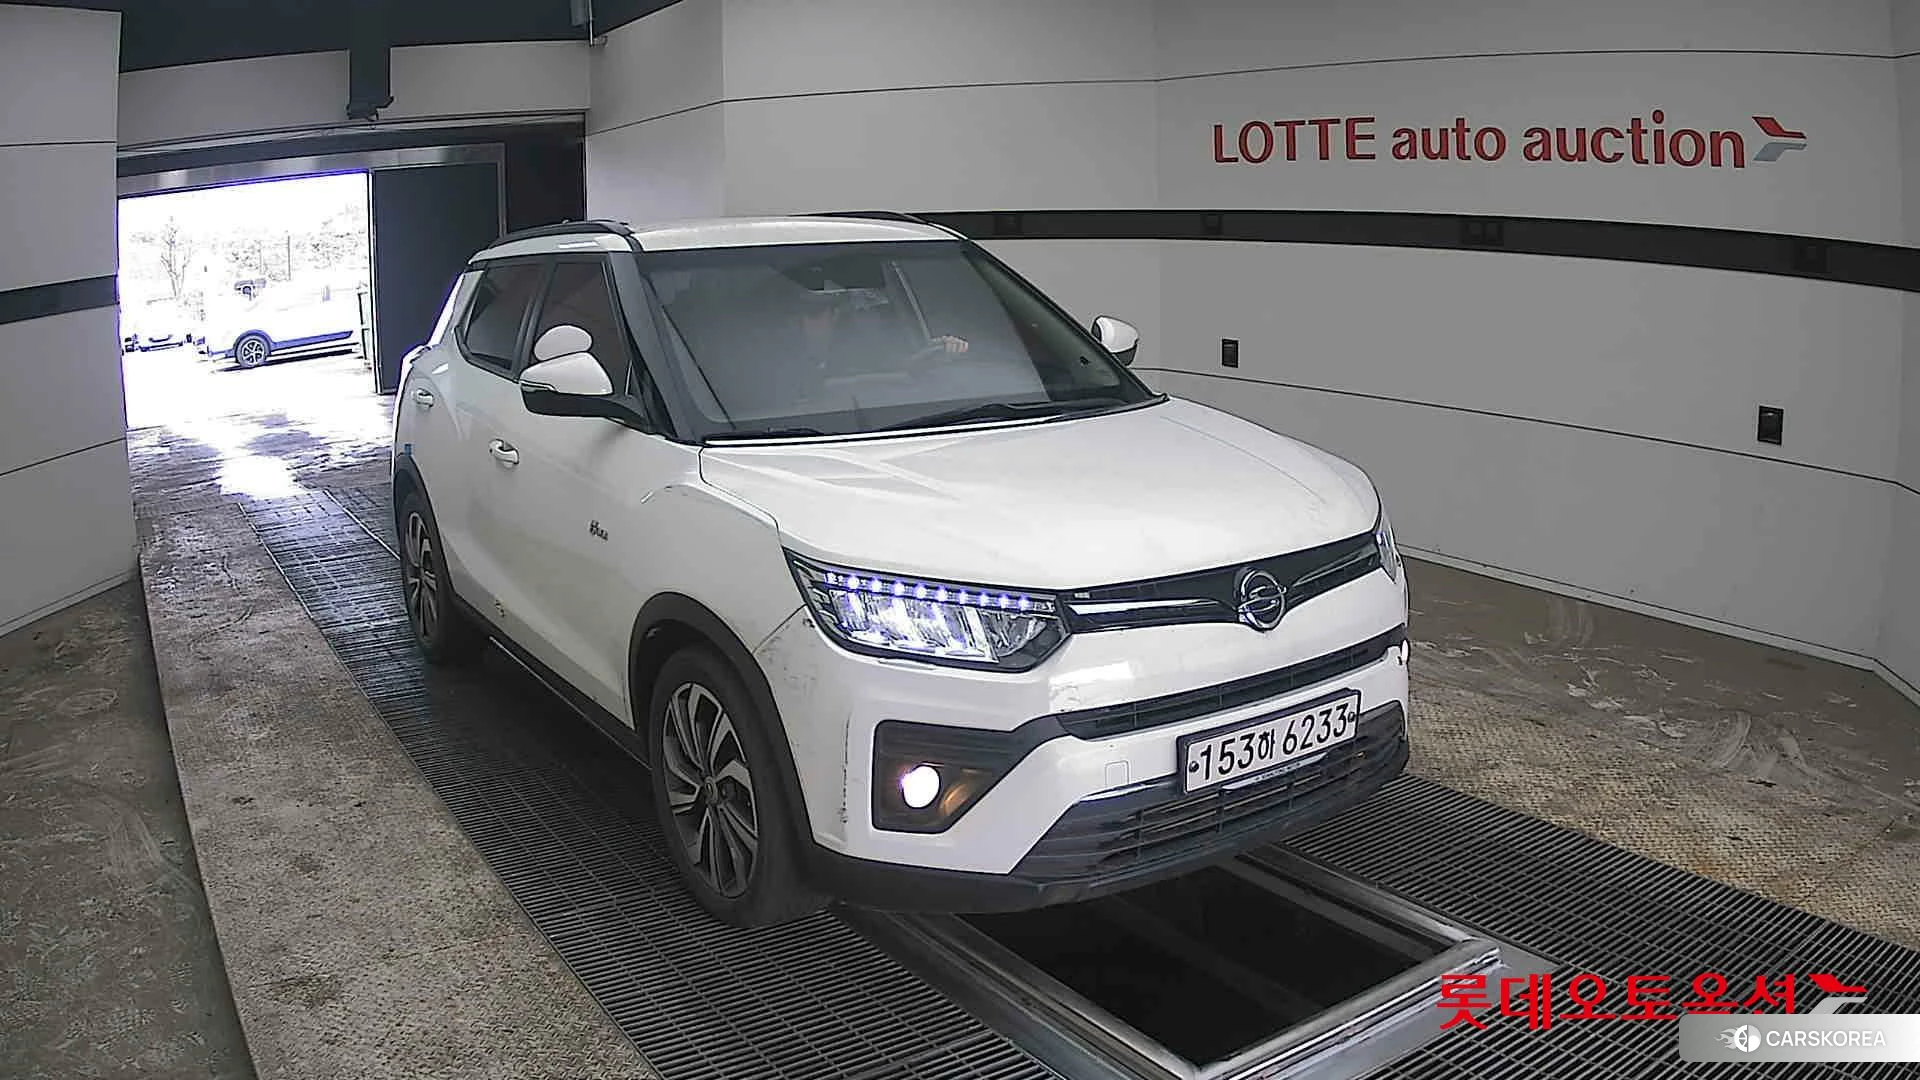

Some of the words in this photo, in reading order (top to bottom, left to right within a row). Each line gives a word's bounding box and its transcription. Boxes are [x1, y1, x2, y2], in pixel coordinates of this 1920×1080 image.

[1213, 116, 1377, 164] LOTTE
[1391, 116, 1507, 162] auto
[1523, 109, 1746, 169] auction
